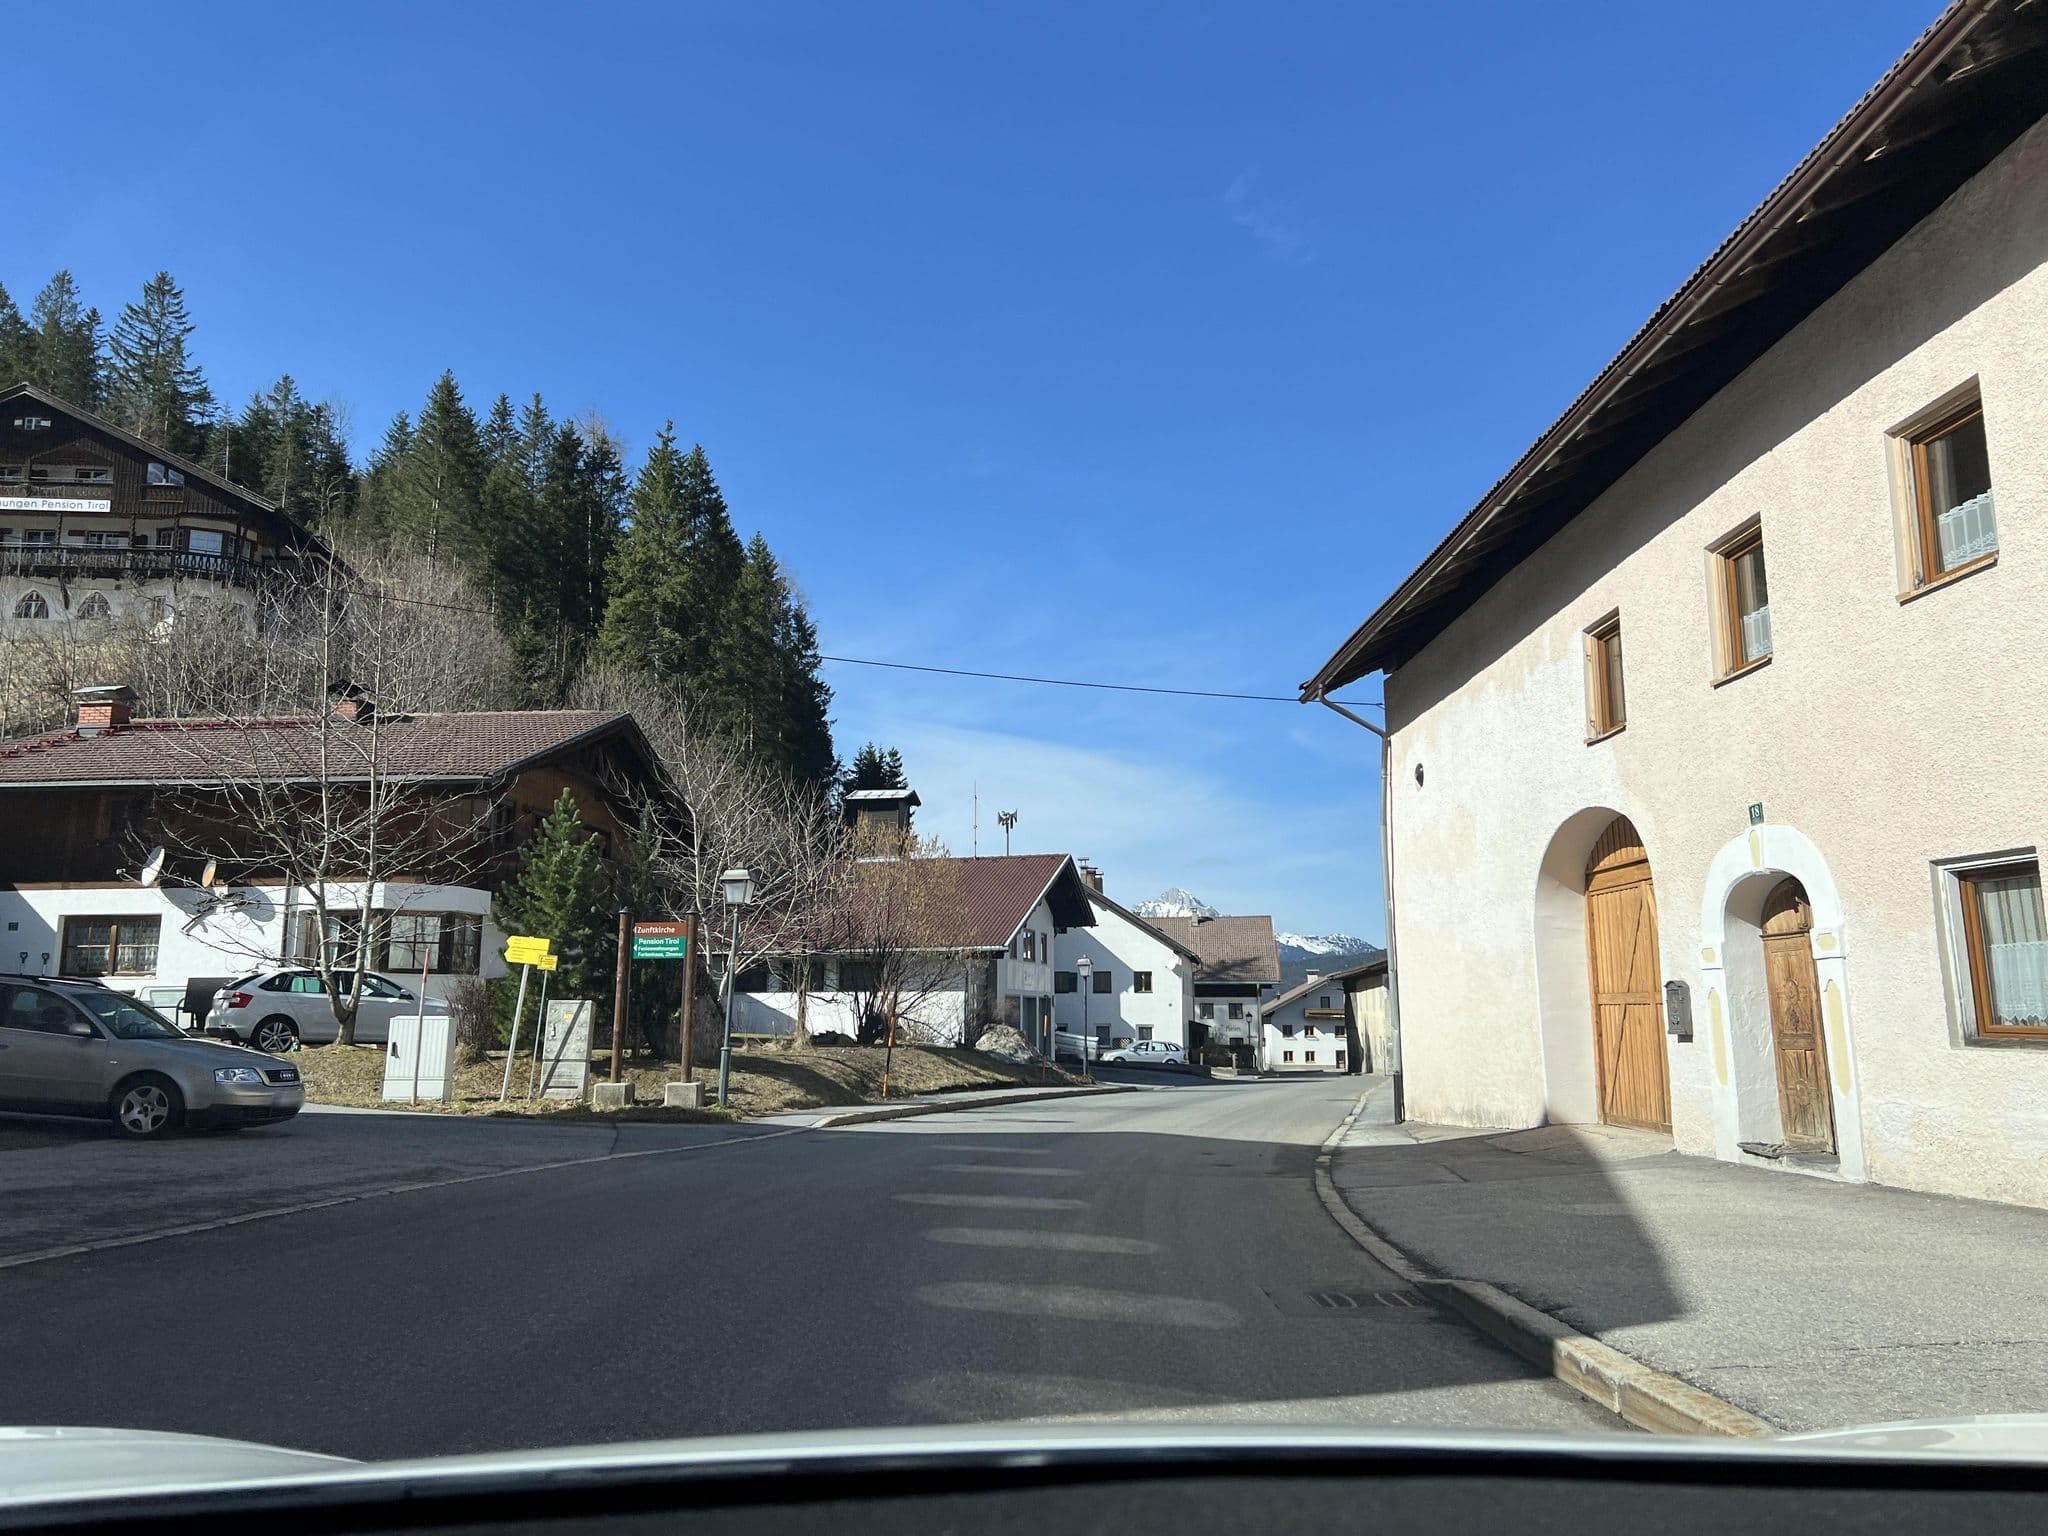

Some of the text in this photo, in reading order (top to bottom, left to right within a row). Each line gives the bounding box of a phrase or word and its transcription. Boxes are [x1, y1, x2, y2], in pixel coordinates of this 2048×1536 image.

[0, 499, 109, 510] ungen Pension Tirol
[1751, 805, 1760, 818] 18
[637, 926, 676, 934] Zunftkirche
